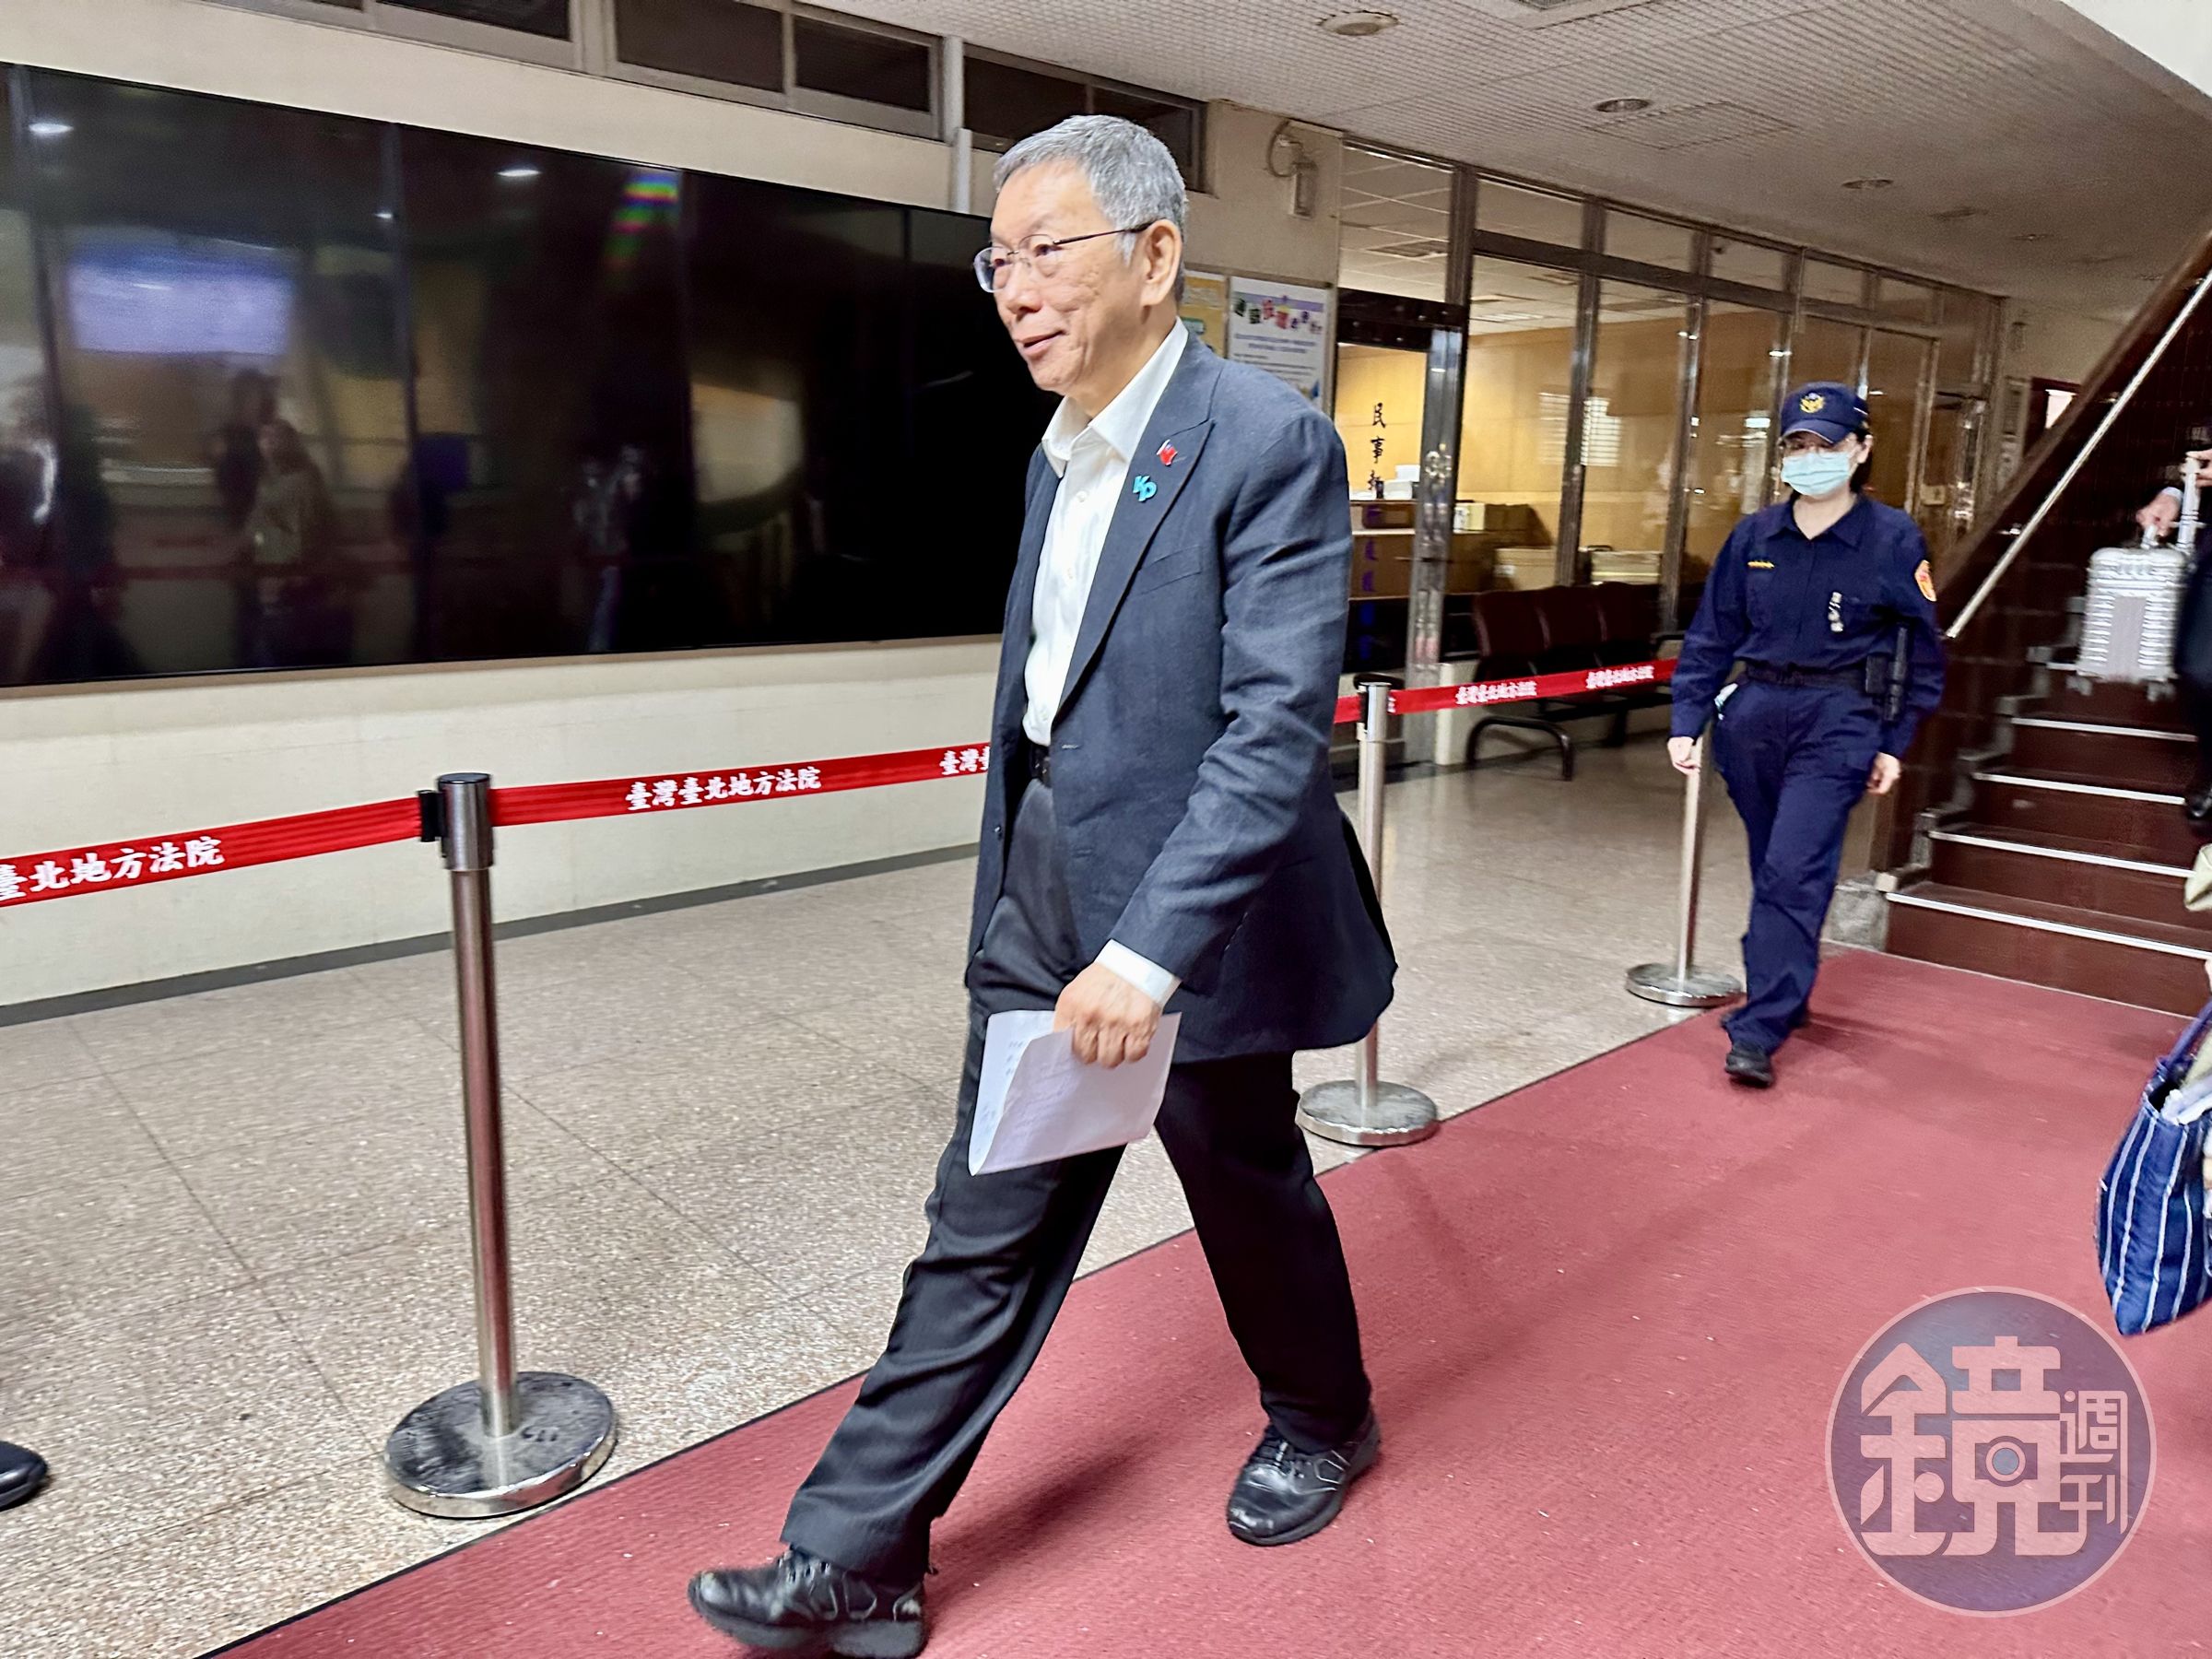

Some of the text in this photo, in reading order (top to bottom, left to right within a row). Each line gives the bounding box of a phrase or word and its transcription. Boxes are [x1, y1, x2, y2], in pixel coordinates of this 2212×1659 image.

[626, 767, 821, 810] 臺灣臺北地方法院
[0, 836, 225, 901] 臺北地方法院
